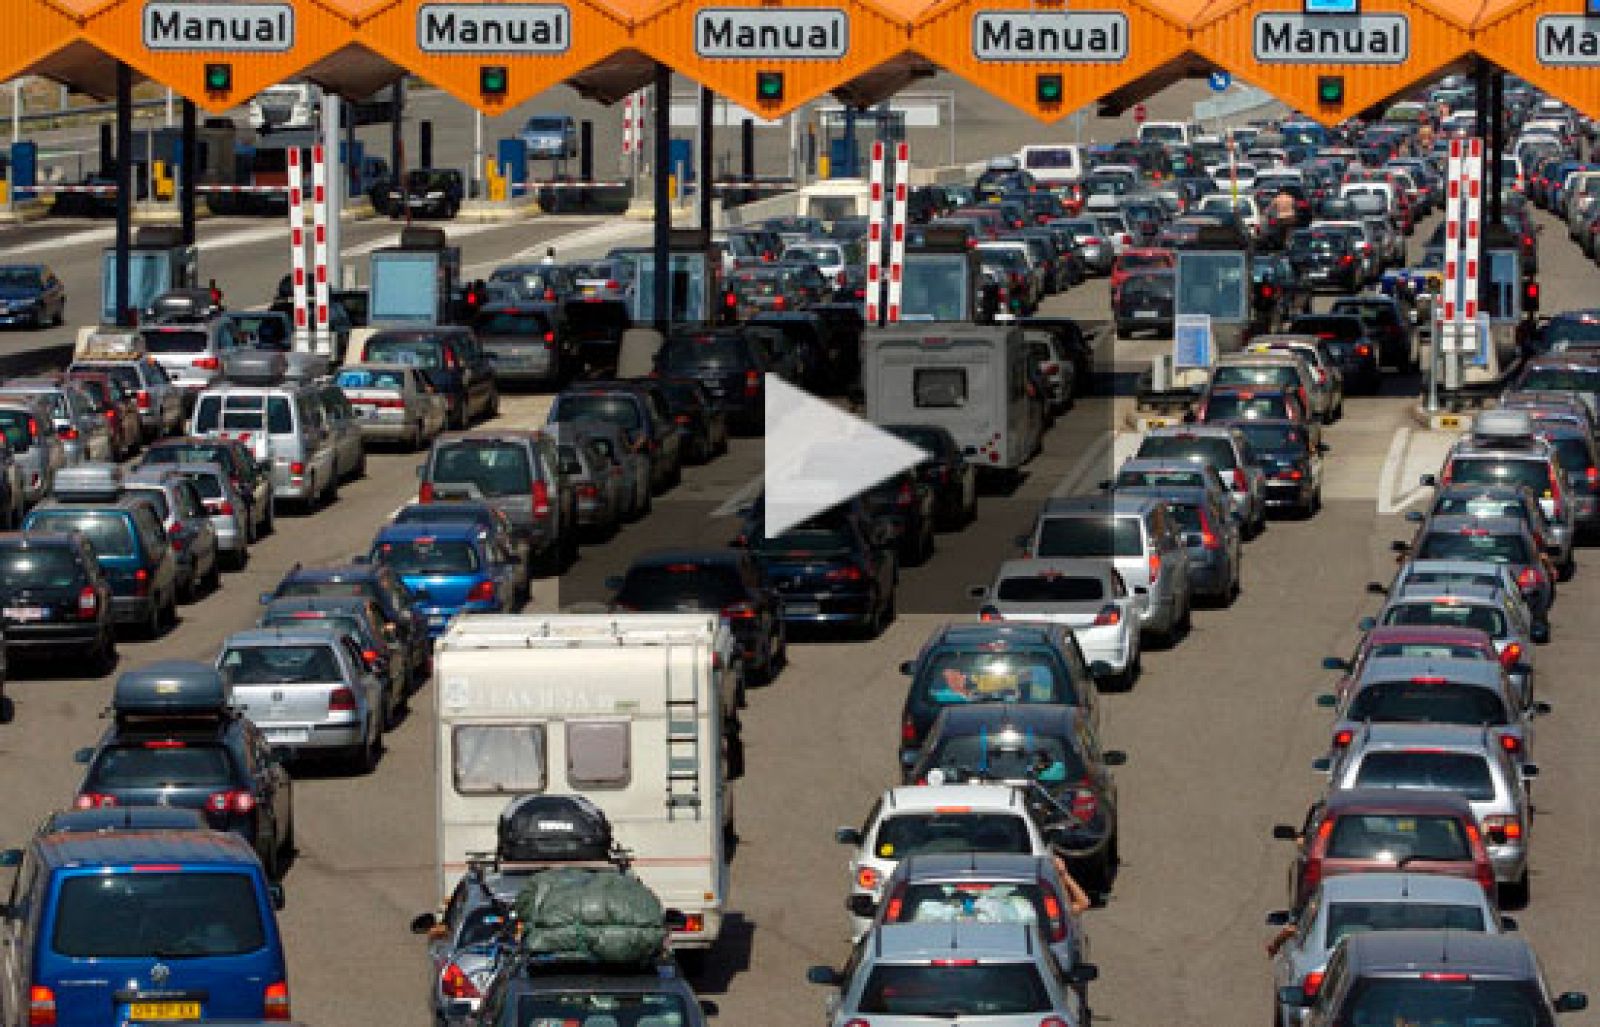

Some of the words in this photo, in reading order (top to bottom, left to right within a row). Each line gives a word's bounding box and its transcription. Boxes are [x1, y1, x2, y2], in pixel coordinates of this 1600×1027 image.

[151, 11, 286, 42] Manual
[426, 14, 562, 44] Manual
[703, 17, 839, 49] Manual
[982, 20, 1118, 52] Manual
[1262, 23, 1400, 54] Manual
